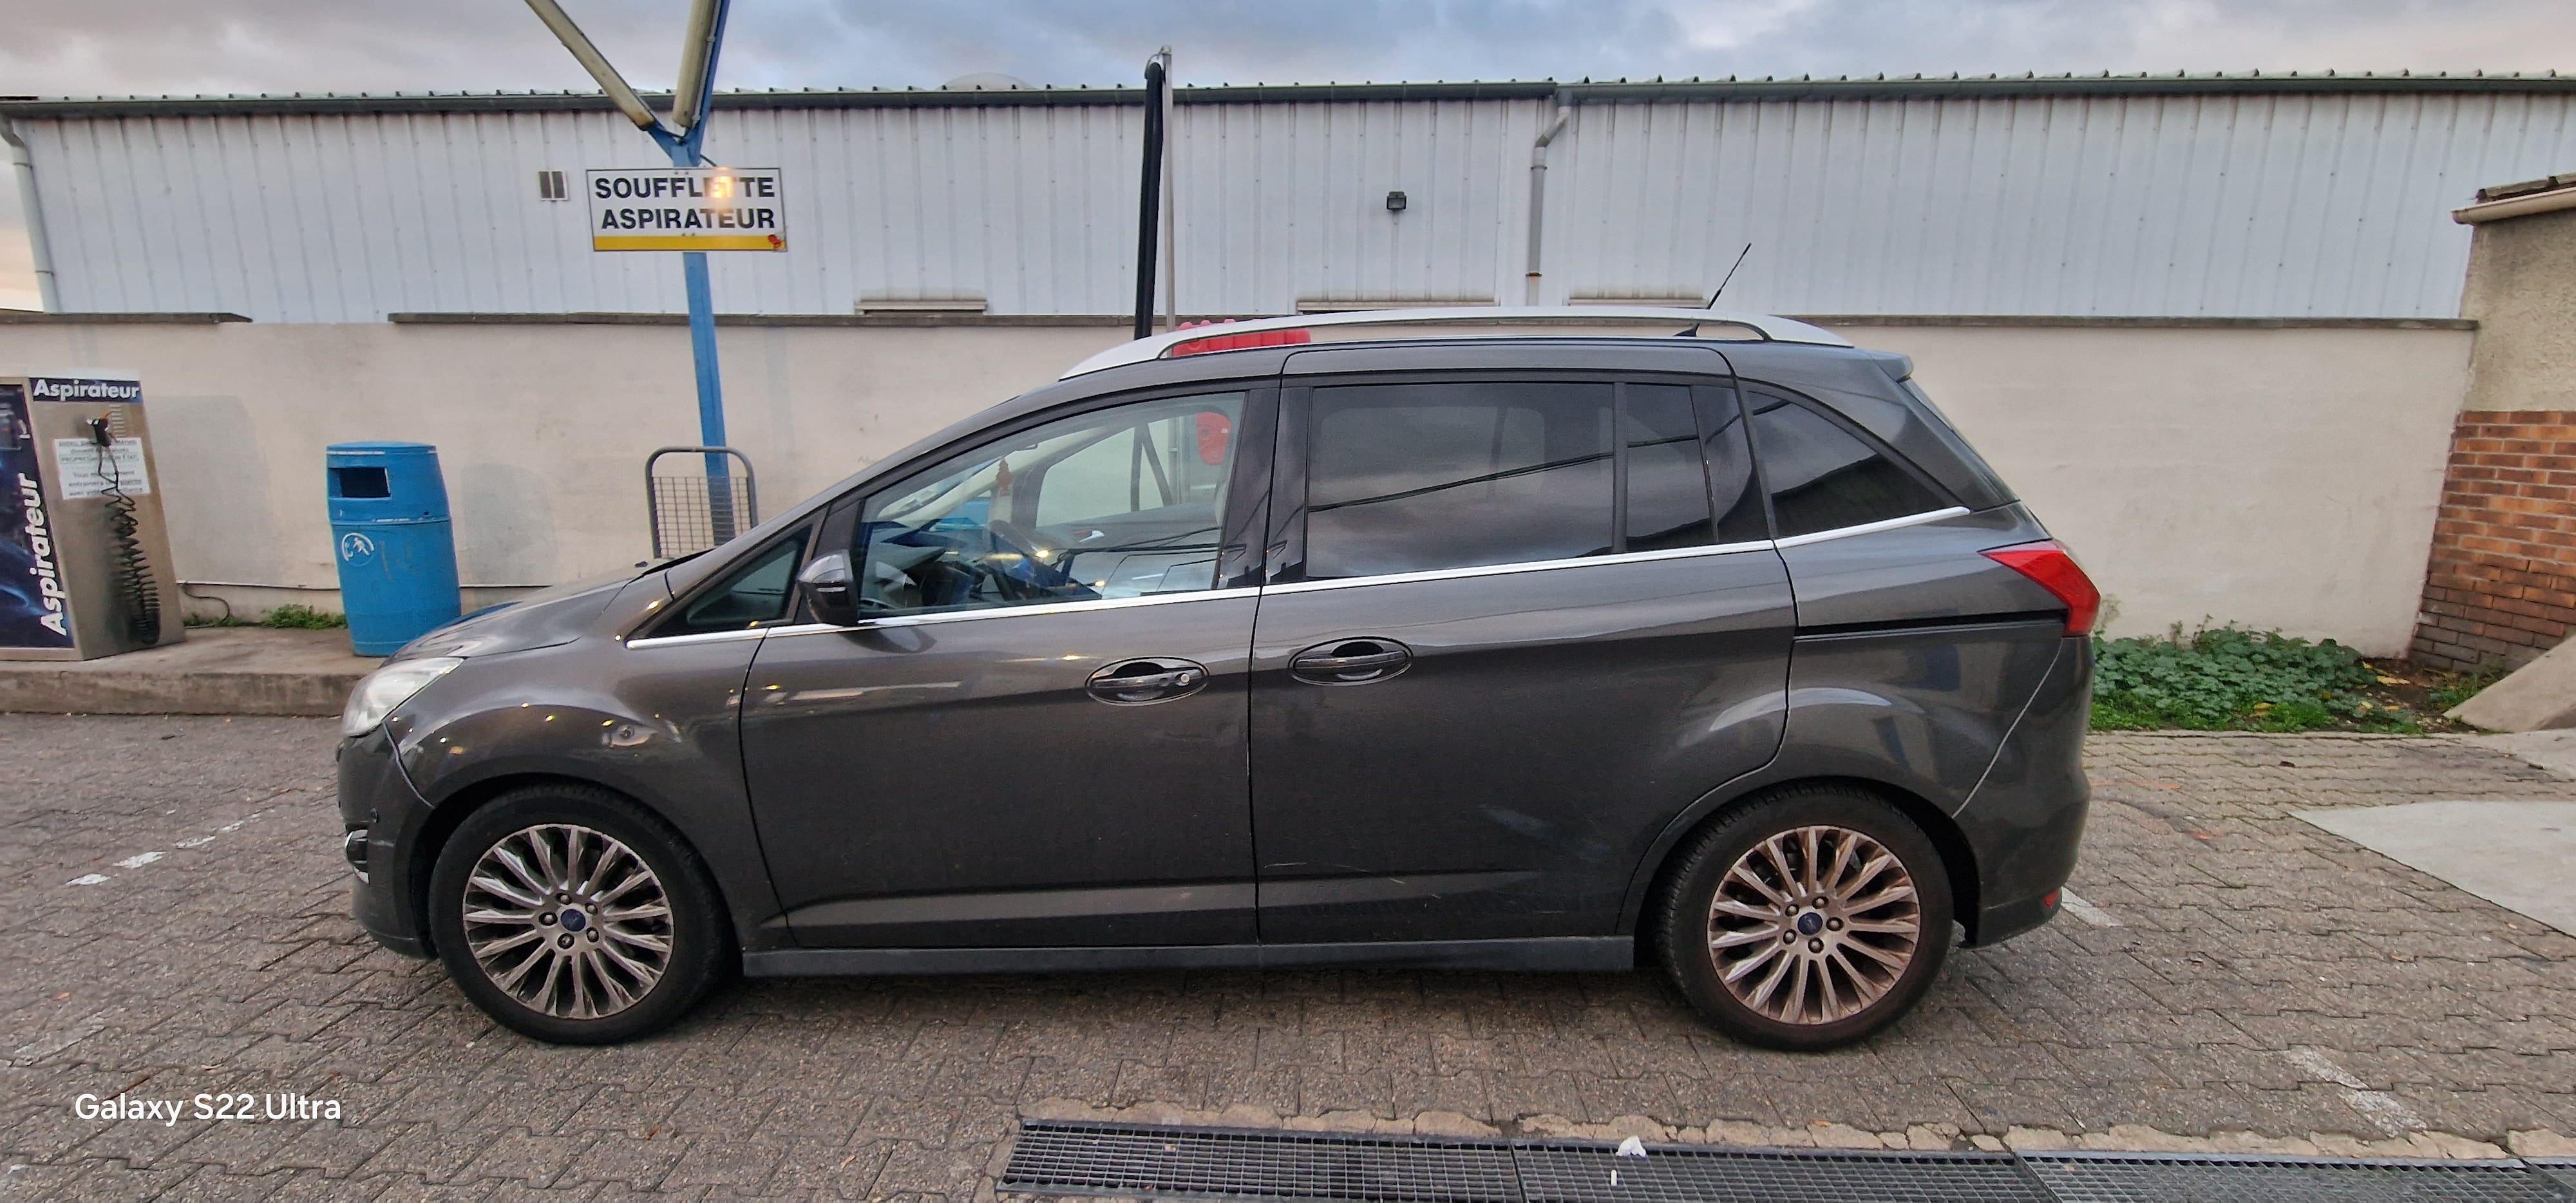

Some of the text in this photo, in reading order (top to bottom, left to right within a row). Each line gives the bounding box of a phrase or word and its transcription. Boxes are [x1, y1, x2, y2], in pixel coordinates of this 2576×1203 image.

[601, 208, 775, 229] ASPIRATEUR
[33, 379, 140, 402] Aspirateur
[17, 472, 67, 636] Aspirateur
